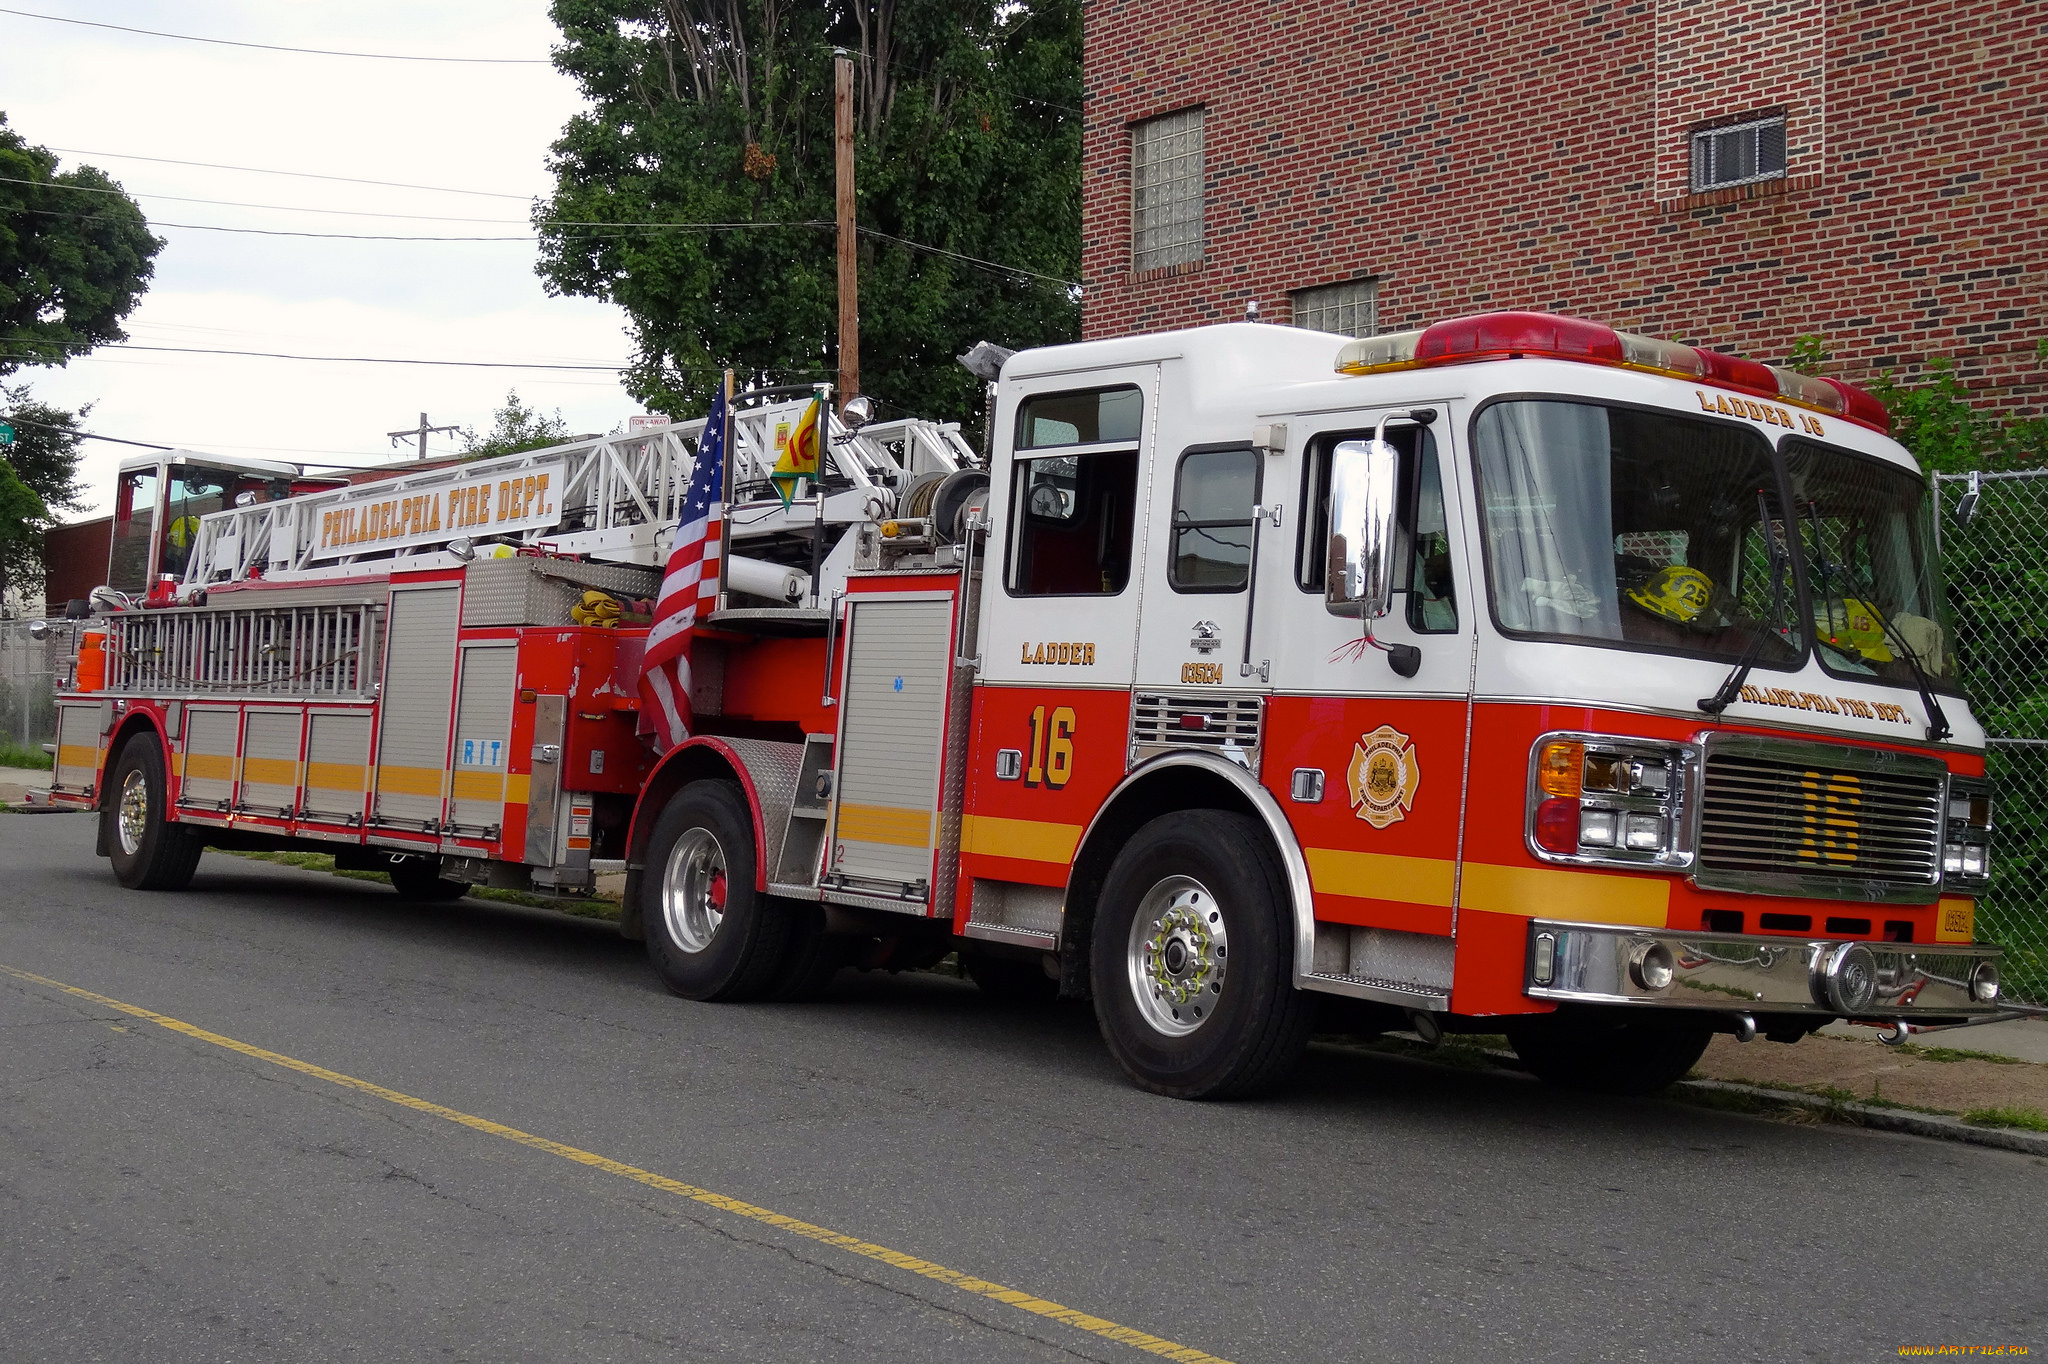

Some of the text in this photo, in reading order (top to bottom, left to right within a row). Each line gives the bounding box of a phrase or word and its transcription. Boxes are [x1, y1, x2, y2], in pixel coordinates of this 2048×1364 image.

[1696, 390, 1825, 437] LADDER 16
[322, 473, 553, 549] PHILADELPHIA FIRE DEPT.
[1681, 583, 1706, 607] 25
[1021, 642, 1096, 666] LADDER
[1181, 662, 1224, 684] 035134
[1737, 684, 1912, 725] HILADELPHIA FIRE DEPT.
[463, 740, 501, 766] RIT
[1024, 705, 1076, 790] 16
[1365, 741, 1403, 759] PHILADELPHIA
[1359, 789, 1404, 811] FIRE DEPARTMENT
[1798, 771, 1862, 868] 16
[836, 844, 845, 862] 2
